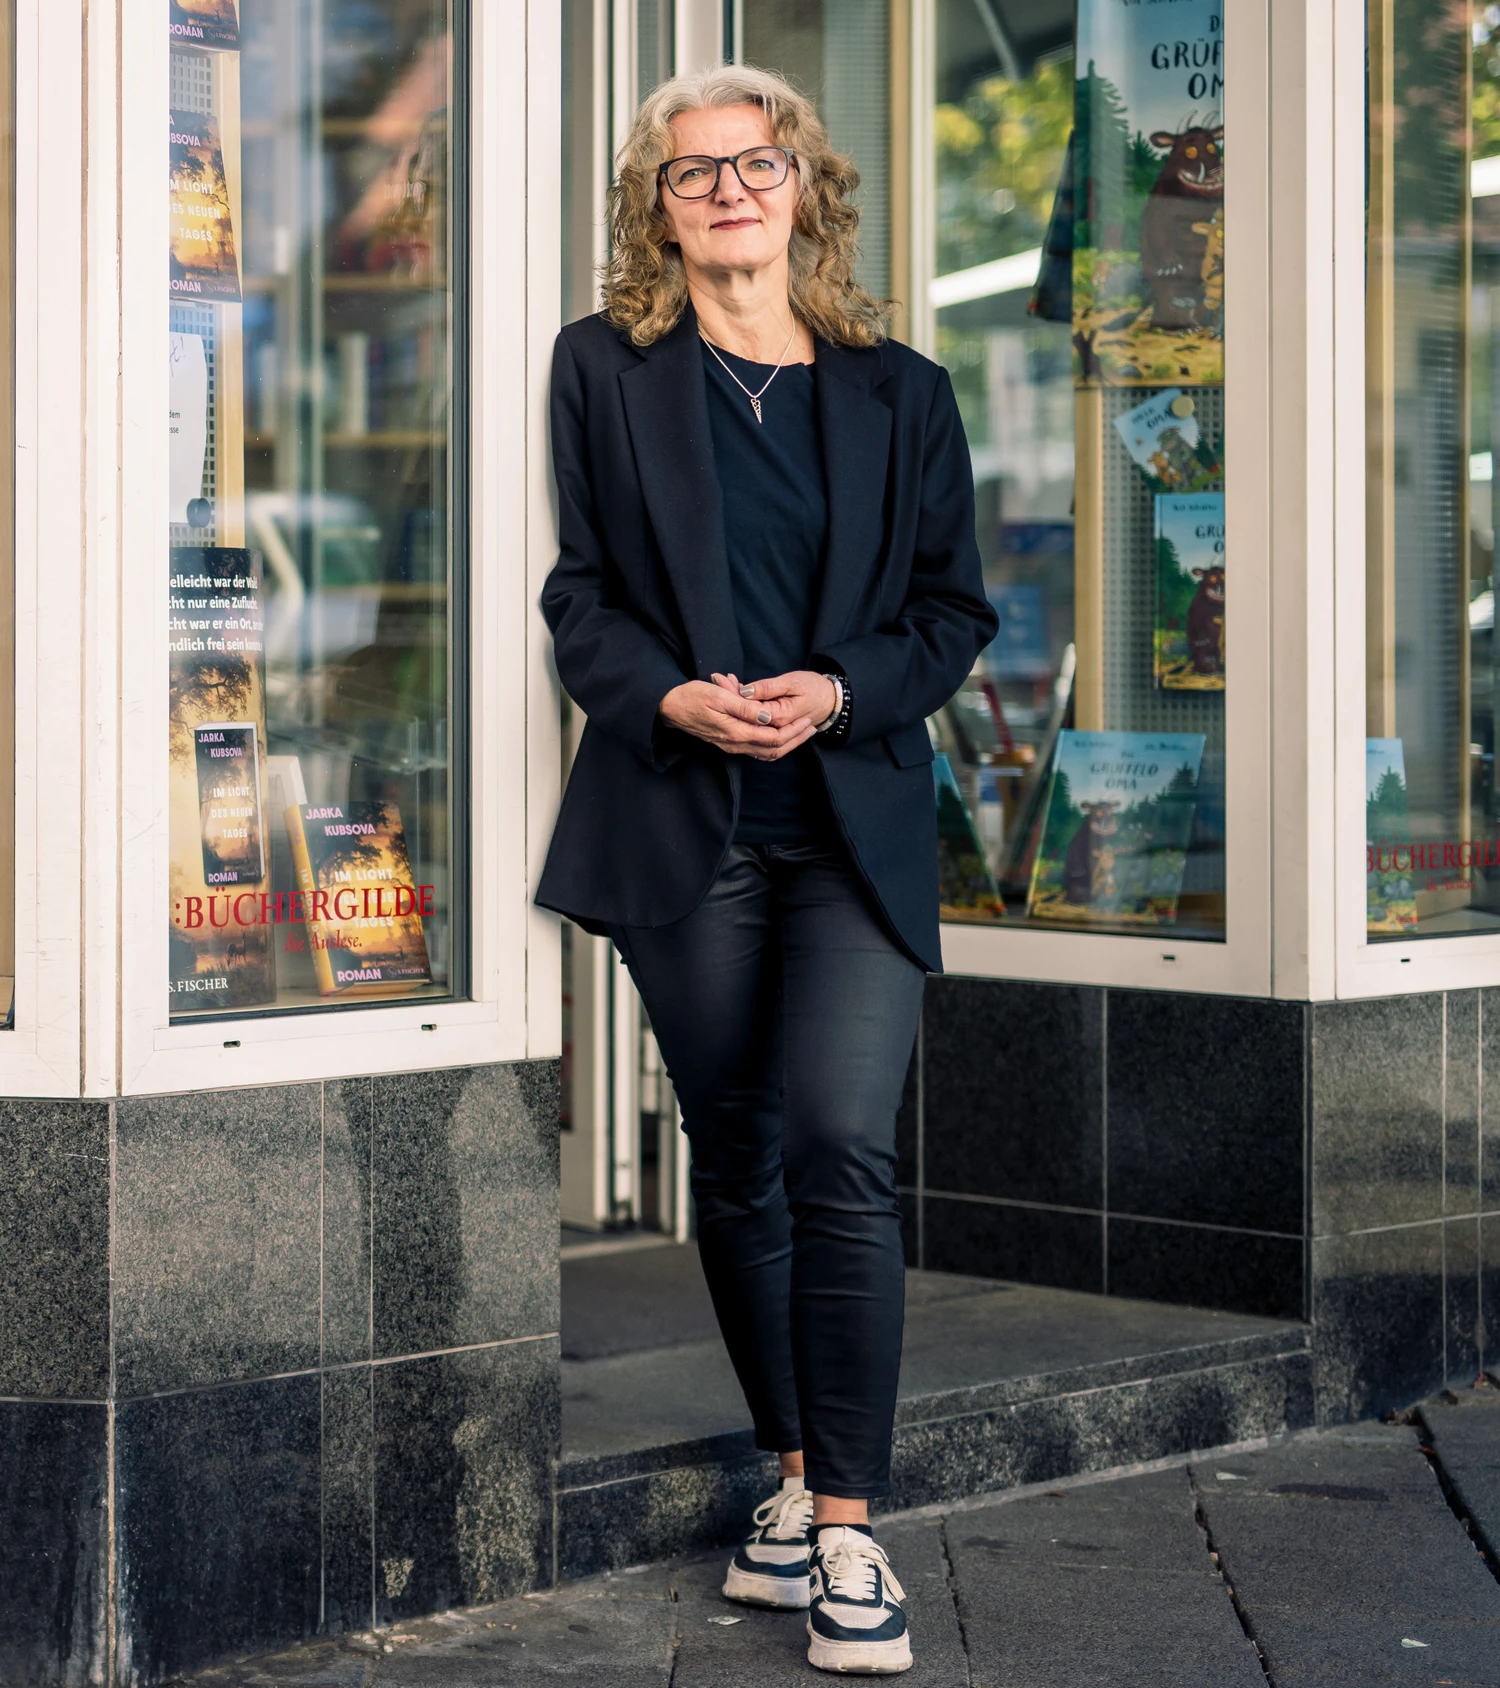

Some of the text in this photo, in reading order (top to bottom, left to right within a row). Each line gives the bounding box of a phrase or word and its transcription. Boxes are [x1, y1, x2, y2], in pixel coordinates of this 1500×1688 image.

[1151, 37, 1223, 70] GRÜF
[1187, 72, 1223, 100] OM
[169, 132, 201, 147] BSOVA
[183, 180, 214, 195] LICHT
[169, 203, 221, 219] ES NEUEN
[180, 227, 213, 242] TAGES
[170, 573, 212, 588] elleicht
[213, 577, 232, 588] war
[232, 574, 246, 588] der
[187, 598, 208, 609] nur
[209, 595, 231, 609] eine
[169, 616, 187, 630] cht
[189, 619, 210, 630] war
[212, 619, 223, 630] er
[224, 616, 239, 630] ein
[239, 617, 253, 632] Ort,
[169, 637, 205, 651] ndlich
[206, 637, 226, 651] frei
[226, 637, 244, 651] sein
[198, 732, 225, 743] JARKA
[210, 747, 243, 758] KUBSOVA
[213, 786, 250, 798] IM LICHT
[211, 807, 253, 819] DES NEUEN
[305, 807, 344, 820] JARKA
[222, 827, 248, 839] TAGES
[324, 823, 376, 837] KUBSOVA
[208, 872, 238, 883] ROMAN
[334, 868, 393, 883] IM LICHT
[354, 916, 395, 929] TAGES
[284, 931, 305, 953] die
[308, 928, 363, 951] Auslese.
[337, 968, 382, 982] ROMAN
